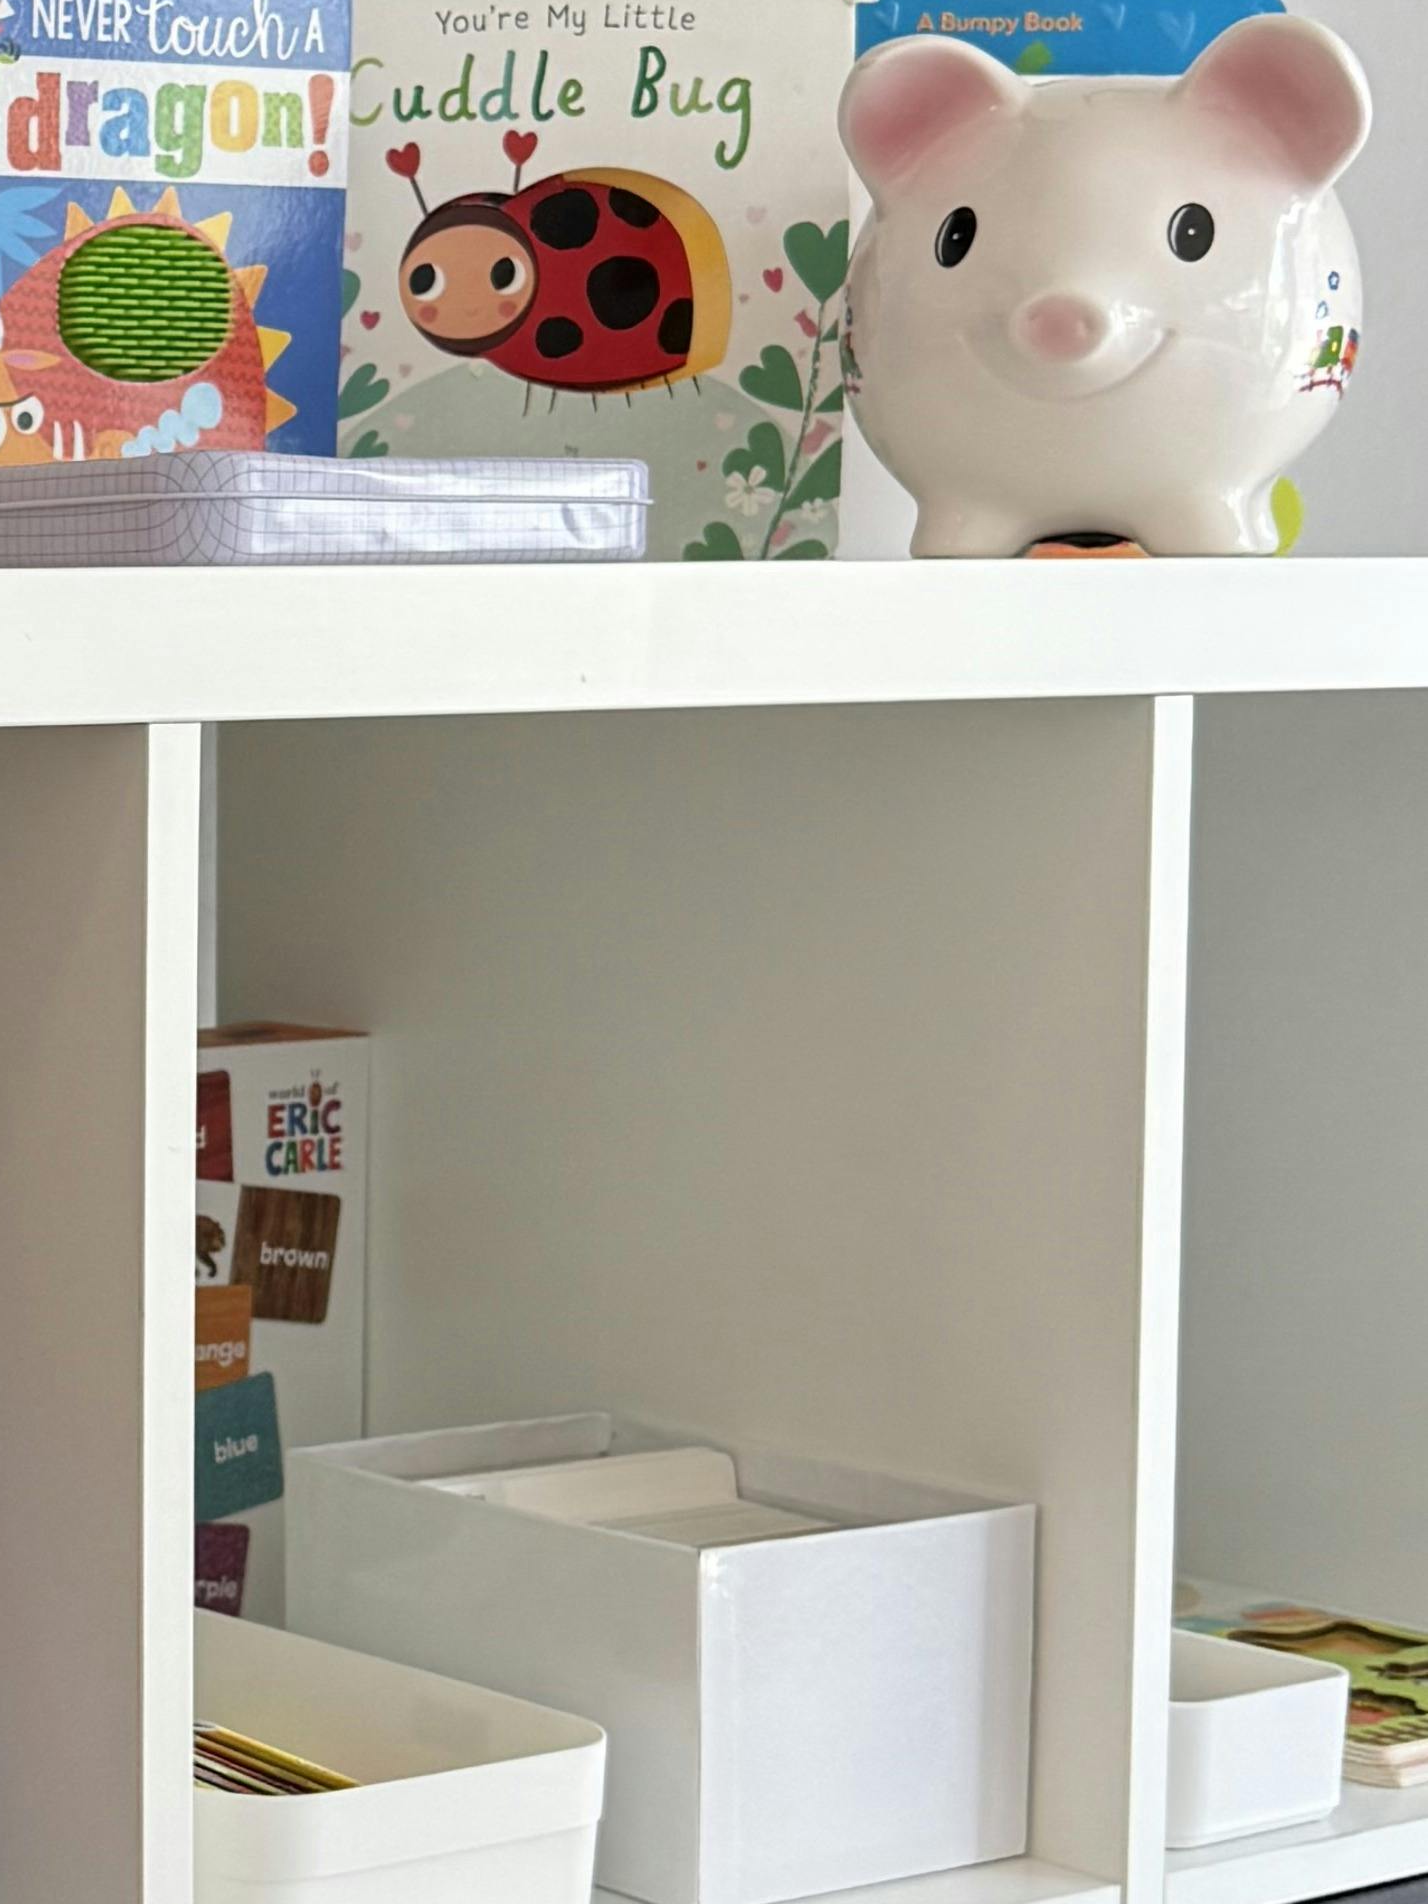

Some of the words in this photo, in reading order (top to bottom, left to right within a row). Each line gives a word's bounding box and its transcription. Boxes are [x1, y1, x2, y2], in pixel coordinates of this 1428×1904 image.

[304, 7, 325, 53] A
[434, 5, 531, 35] You're
[547, 4, 587, 36] My
[603, 4, 696, 32] Little
[916, 12, 934, 32] A
[940, 11, 1019, 36] Bumpy
[1023, 10, 1083, 32] Book
[6, 71, 335, 179] dragon!
[349, 49, 586, 127] Cuddle
[630, 45, 752, 170] Bug
[265, 1137, 343, 1176] CARLE
[260, 1241, 329, 1270] brown
[214, 1434, 259, 1464] blue
